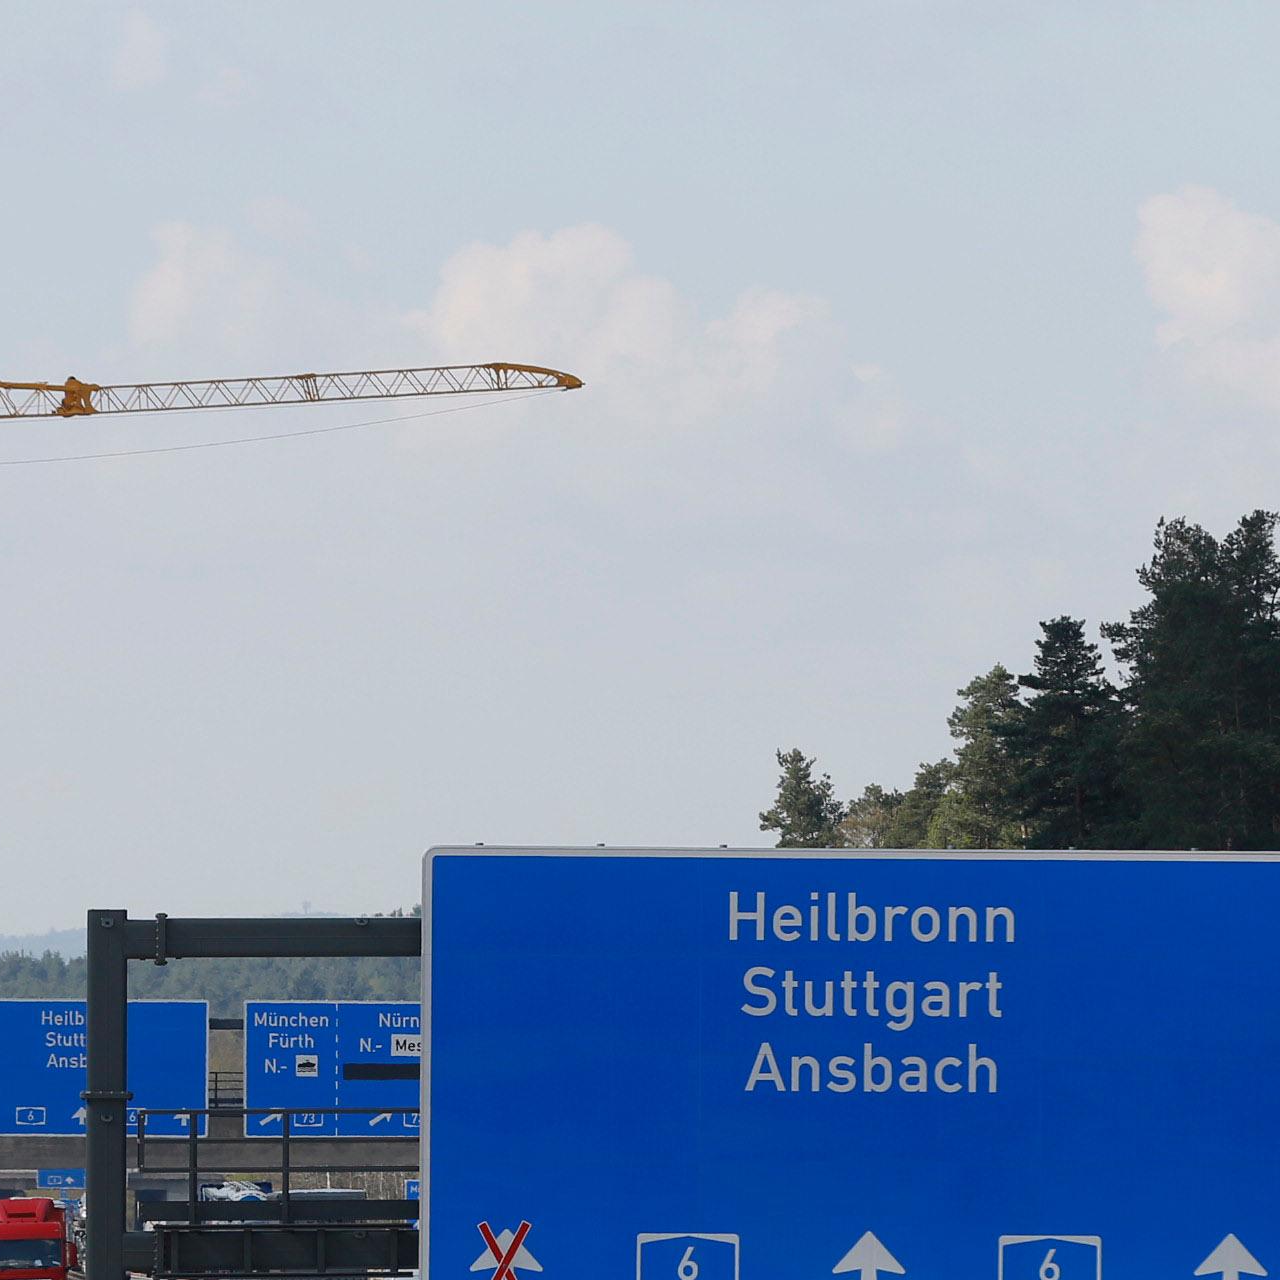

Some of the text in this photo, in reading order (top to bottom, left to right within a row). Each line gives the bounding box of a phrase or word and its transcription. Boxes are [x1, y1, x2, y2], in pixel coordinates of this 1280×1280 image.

[730, 892, 1014, 942] Heilbronn
[741, 967, 1002, 1030] Stuttgart
[254, 1012, 329, 1027] München
[269, 1033, 314, 1049] Fürth
[360, 1038, 383, 1052] N.-
[264, 1058, 288, 1073] N.-
[745, 1042, 997, 1093] Ansbach
[27, 1111, 35, 1121] 6
[129, 1112, 136, 1122] 6
[302, 1113, 316, 1124] 73
